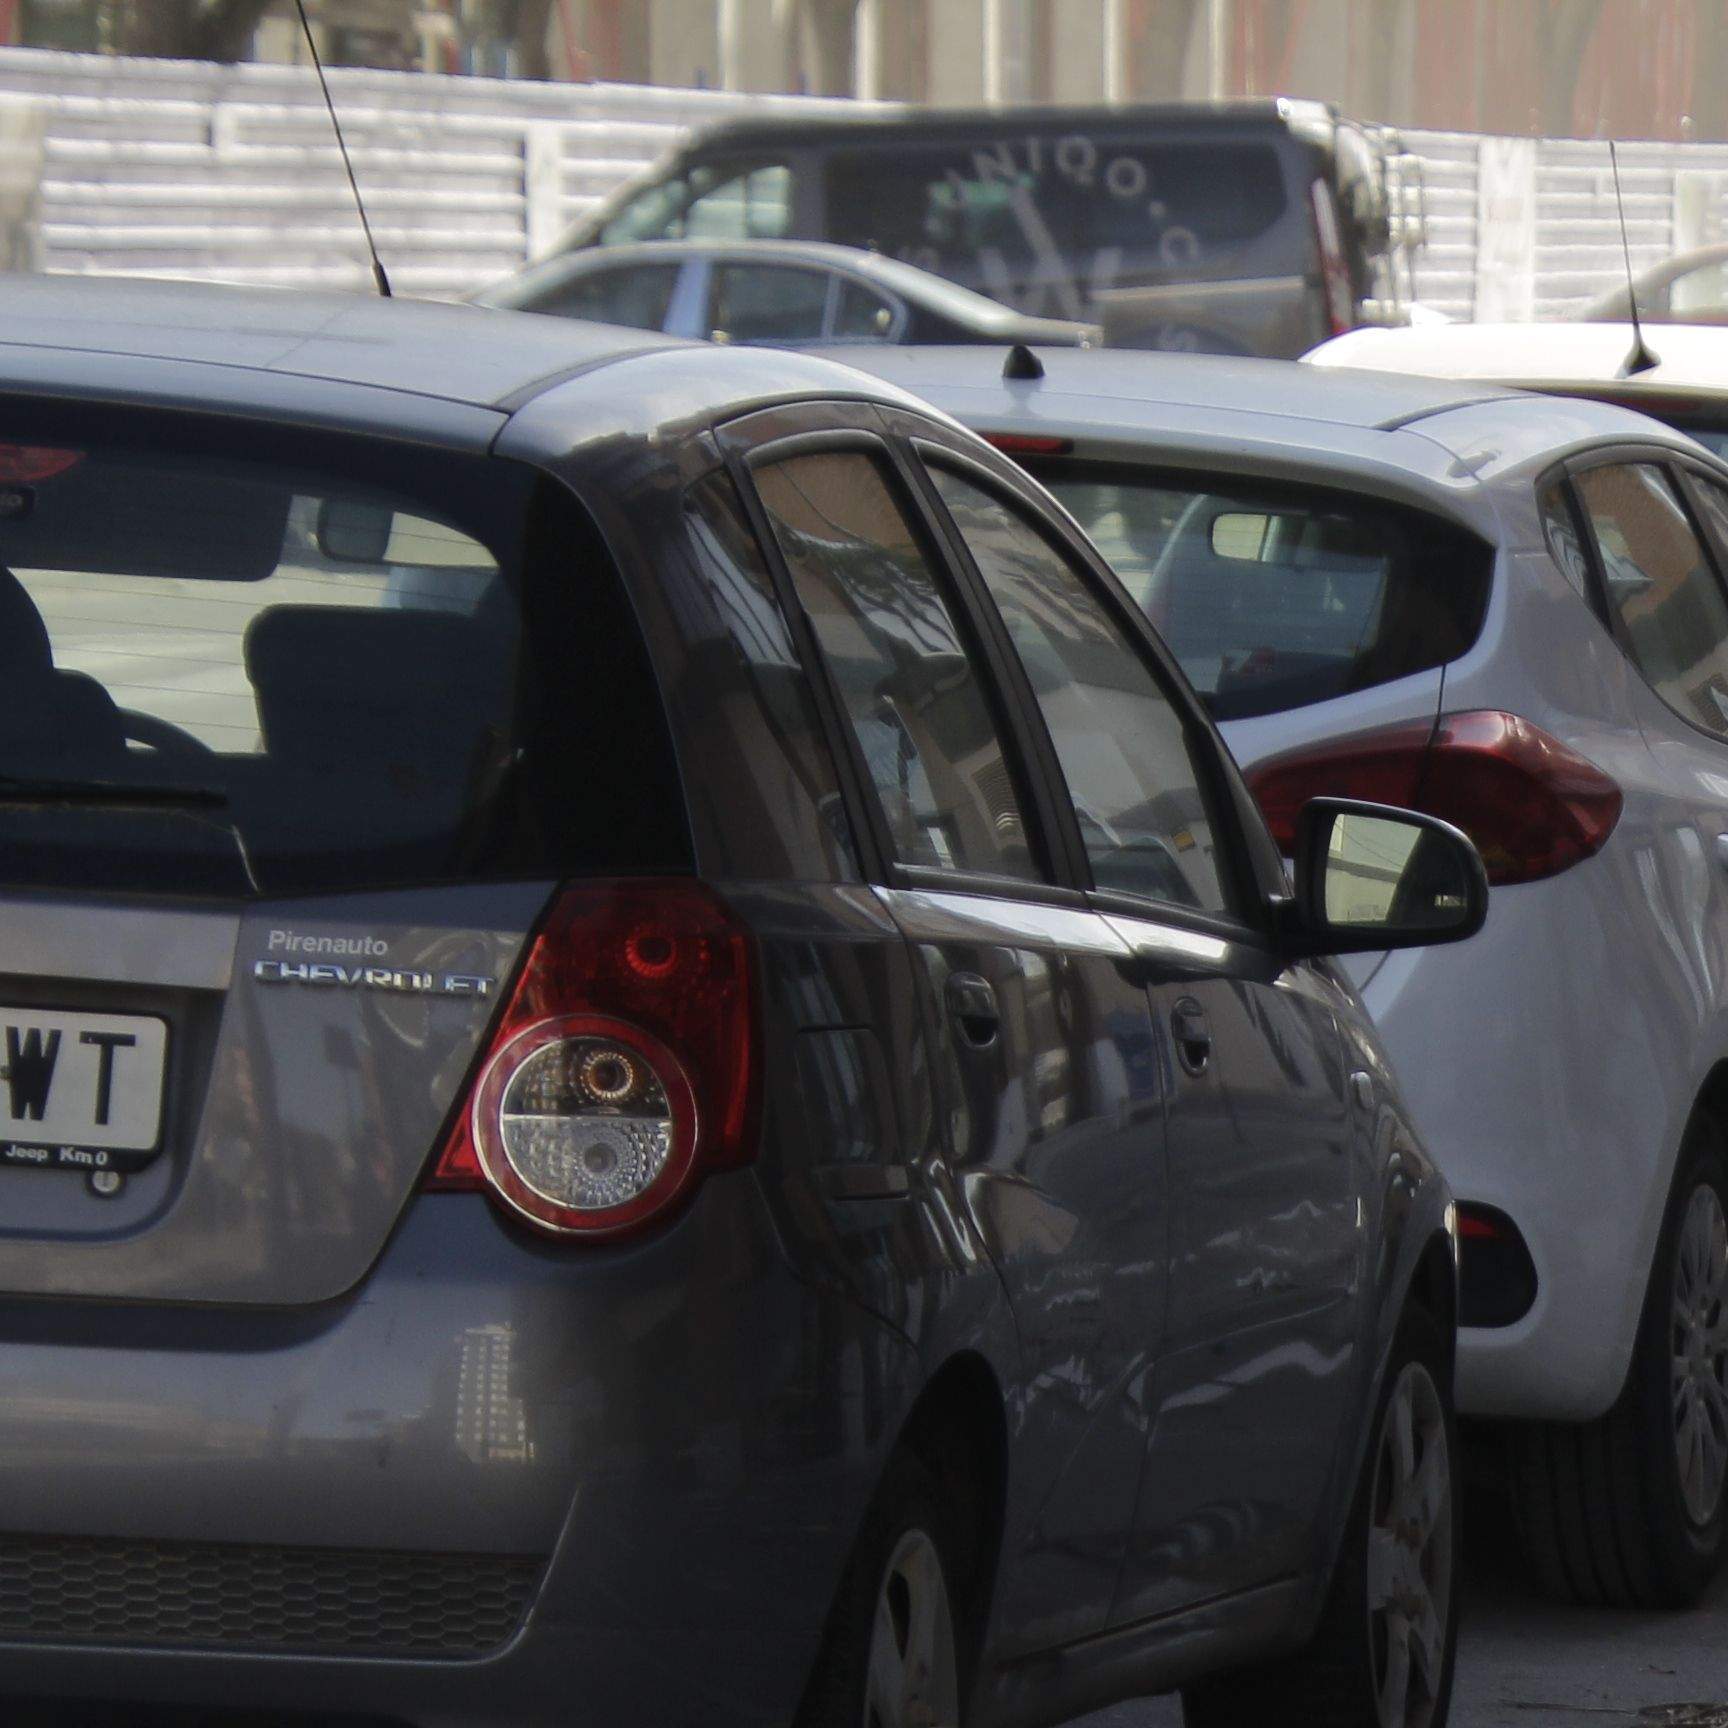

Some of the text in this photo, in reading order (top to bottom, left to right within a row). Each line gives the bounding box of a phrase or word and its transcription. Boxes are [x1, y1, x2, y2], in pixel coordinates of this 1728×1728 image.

[267, 929, 389, 957] Pirenauto
[253, 959, 496, 995] CHEVROLET
[5, 1144, 48, 1162] Jeep
